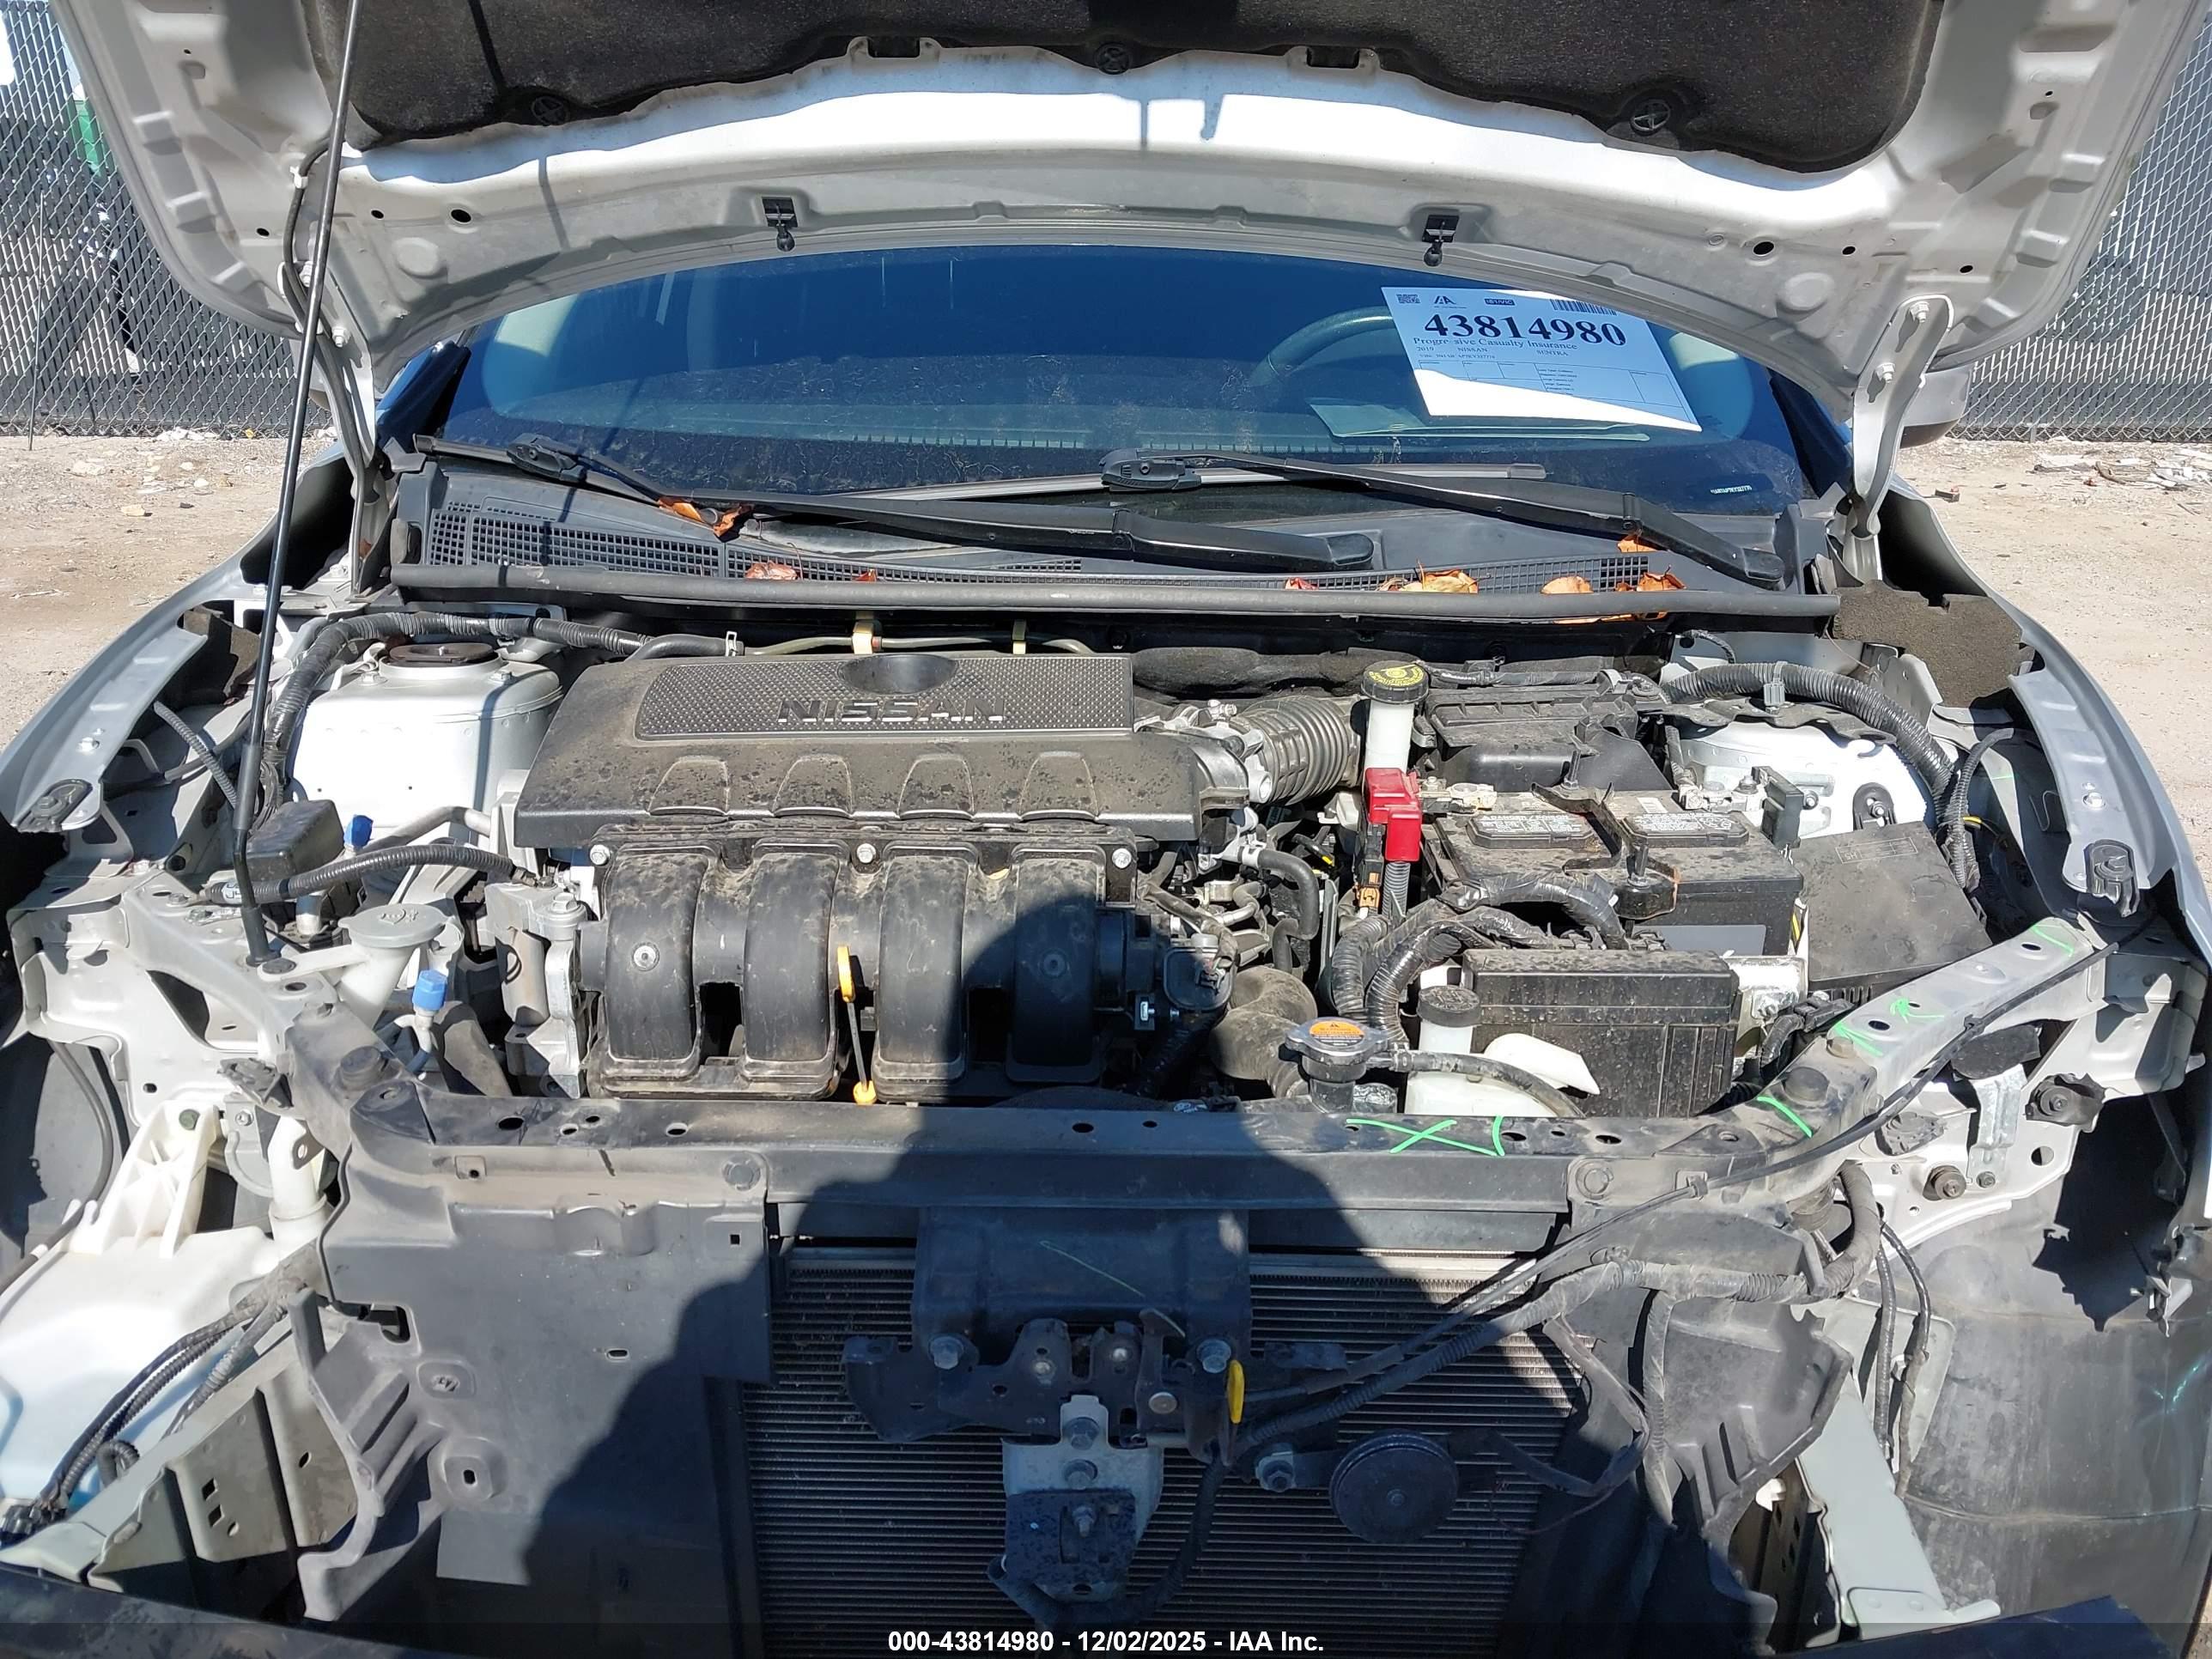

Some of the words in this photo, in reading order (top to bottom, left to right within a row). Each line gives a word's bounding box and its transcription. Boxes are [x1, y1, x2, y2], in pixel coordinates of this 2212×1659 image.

[1424, 313, 1626, 347] 43814980
[1478, 338, 1524, 349] Casualty
[1527, 340, 1578, 350] Insurance
[776, 699, 1006, 723] NISSAN
